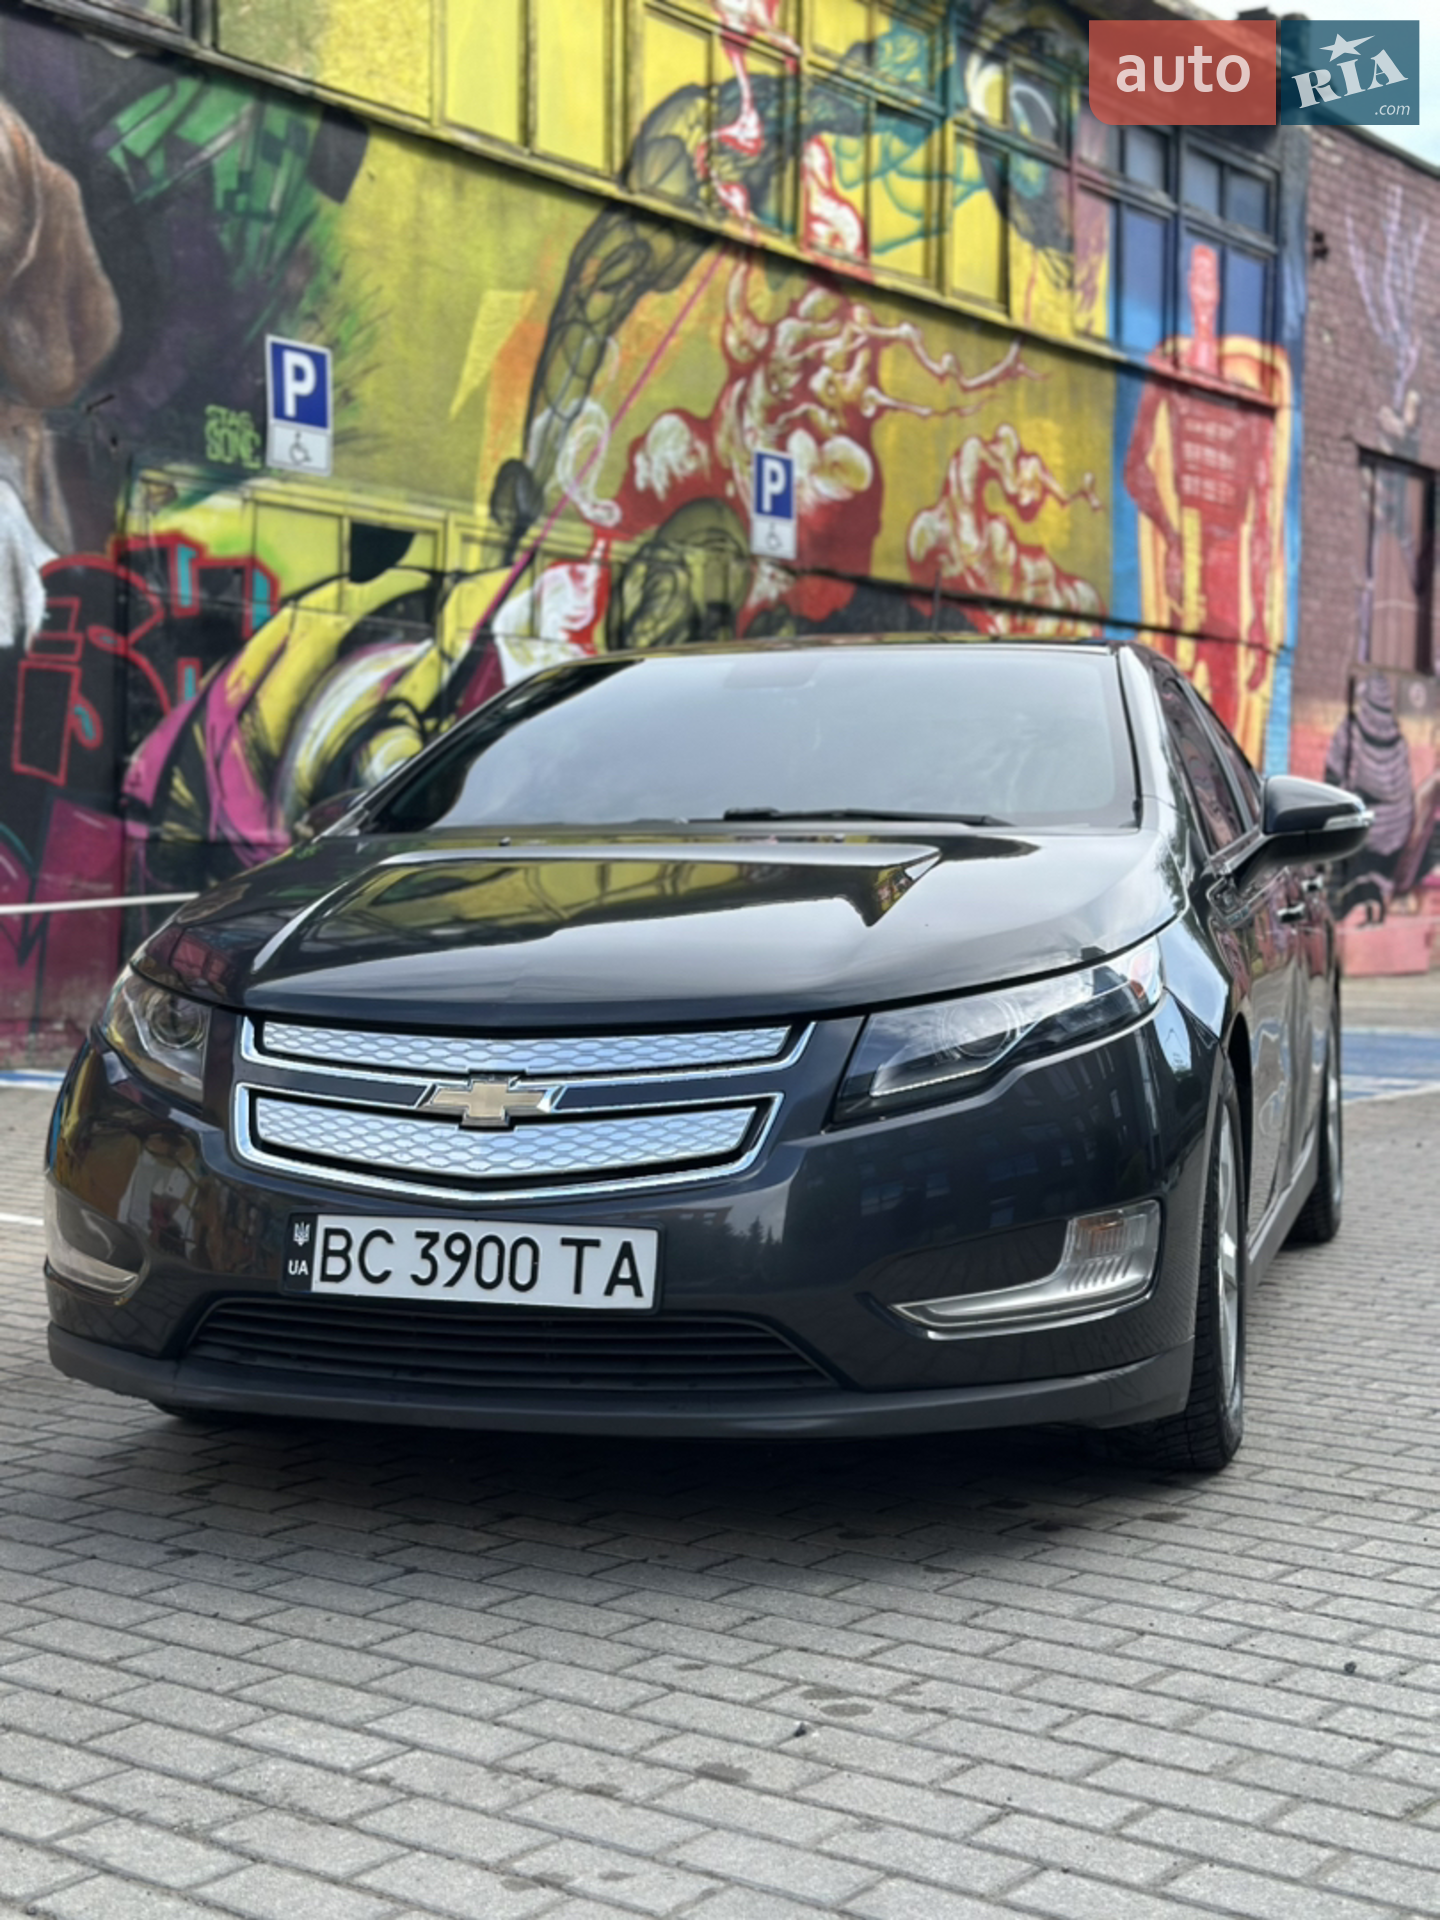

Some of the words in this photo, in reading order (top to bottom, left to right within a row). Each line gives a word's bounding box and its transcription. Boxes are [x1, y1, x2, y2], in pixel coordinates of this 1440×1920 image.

[281, 348, 316, 419] P
[762, 457, 787, 513] P
[288, 1260, 309, 1276] UA
[319, 1227, 394, 1284] BC
[410, 1231, 540, 1292] 3900
[560, 1237, 644, 1298] TA
